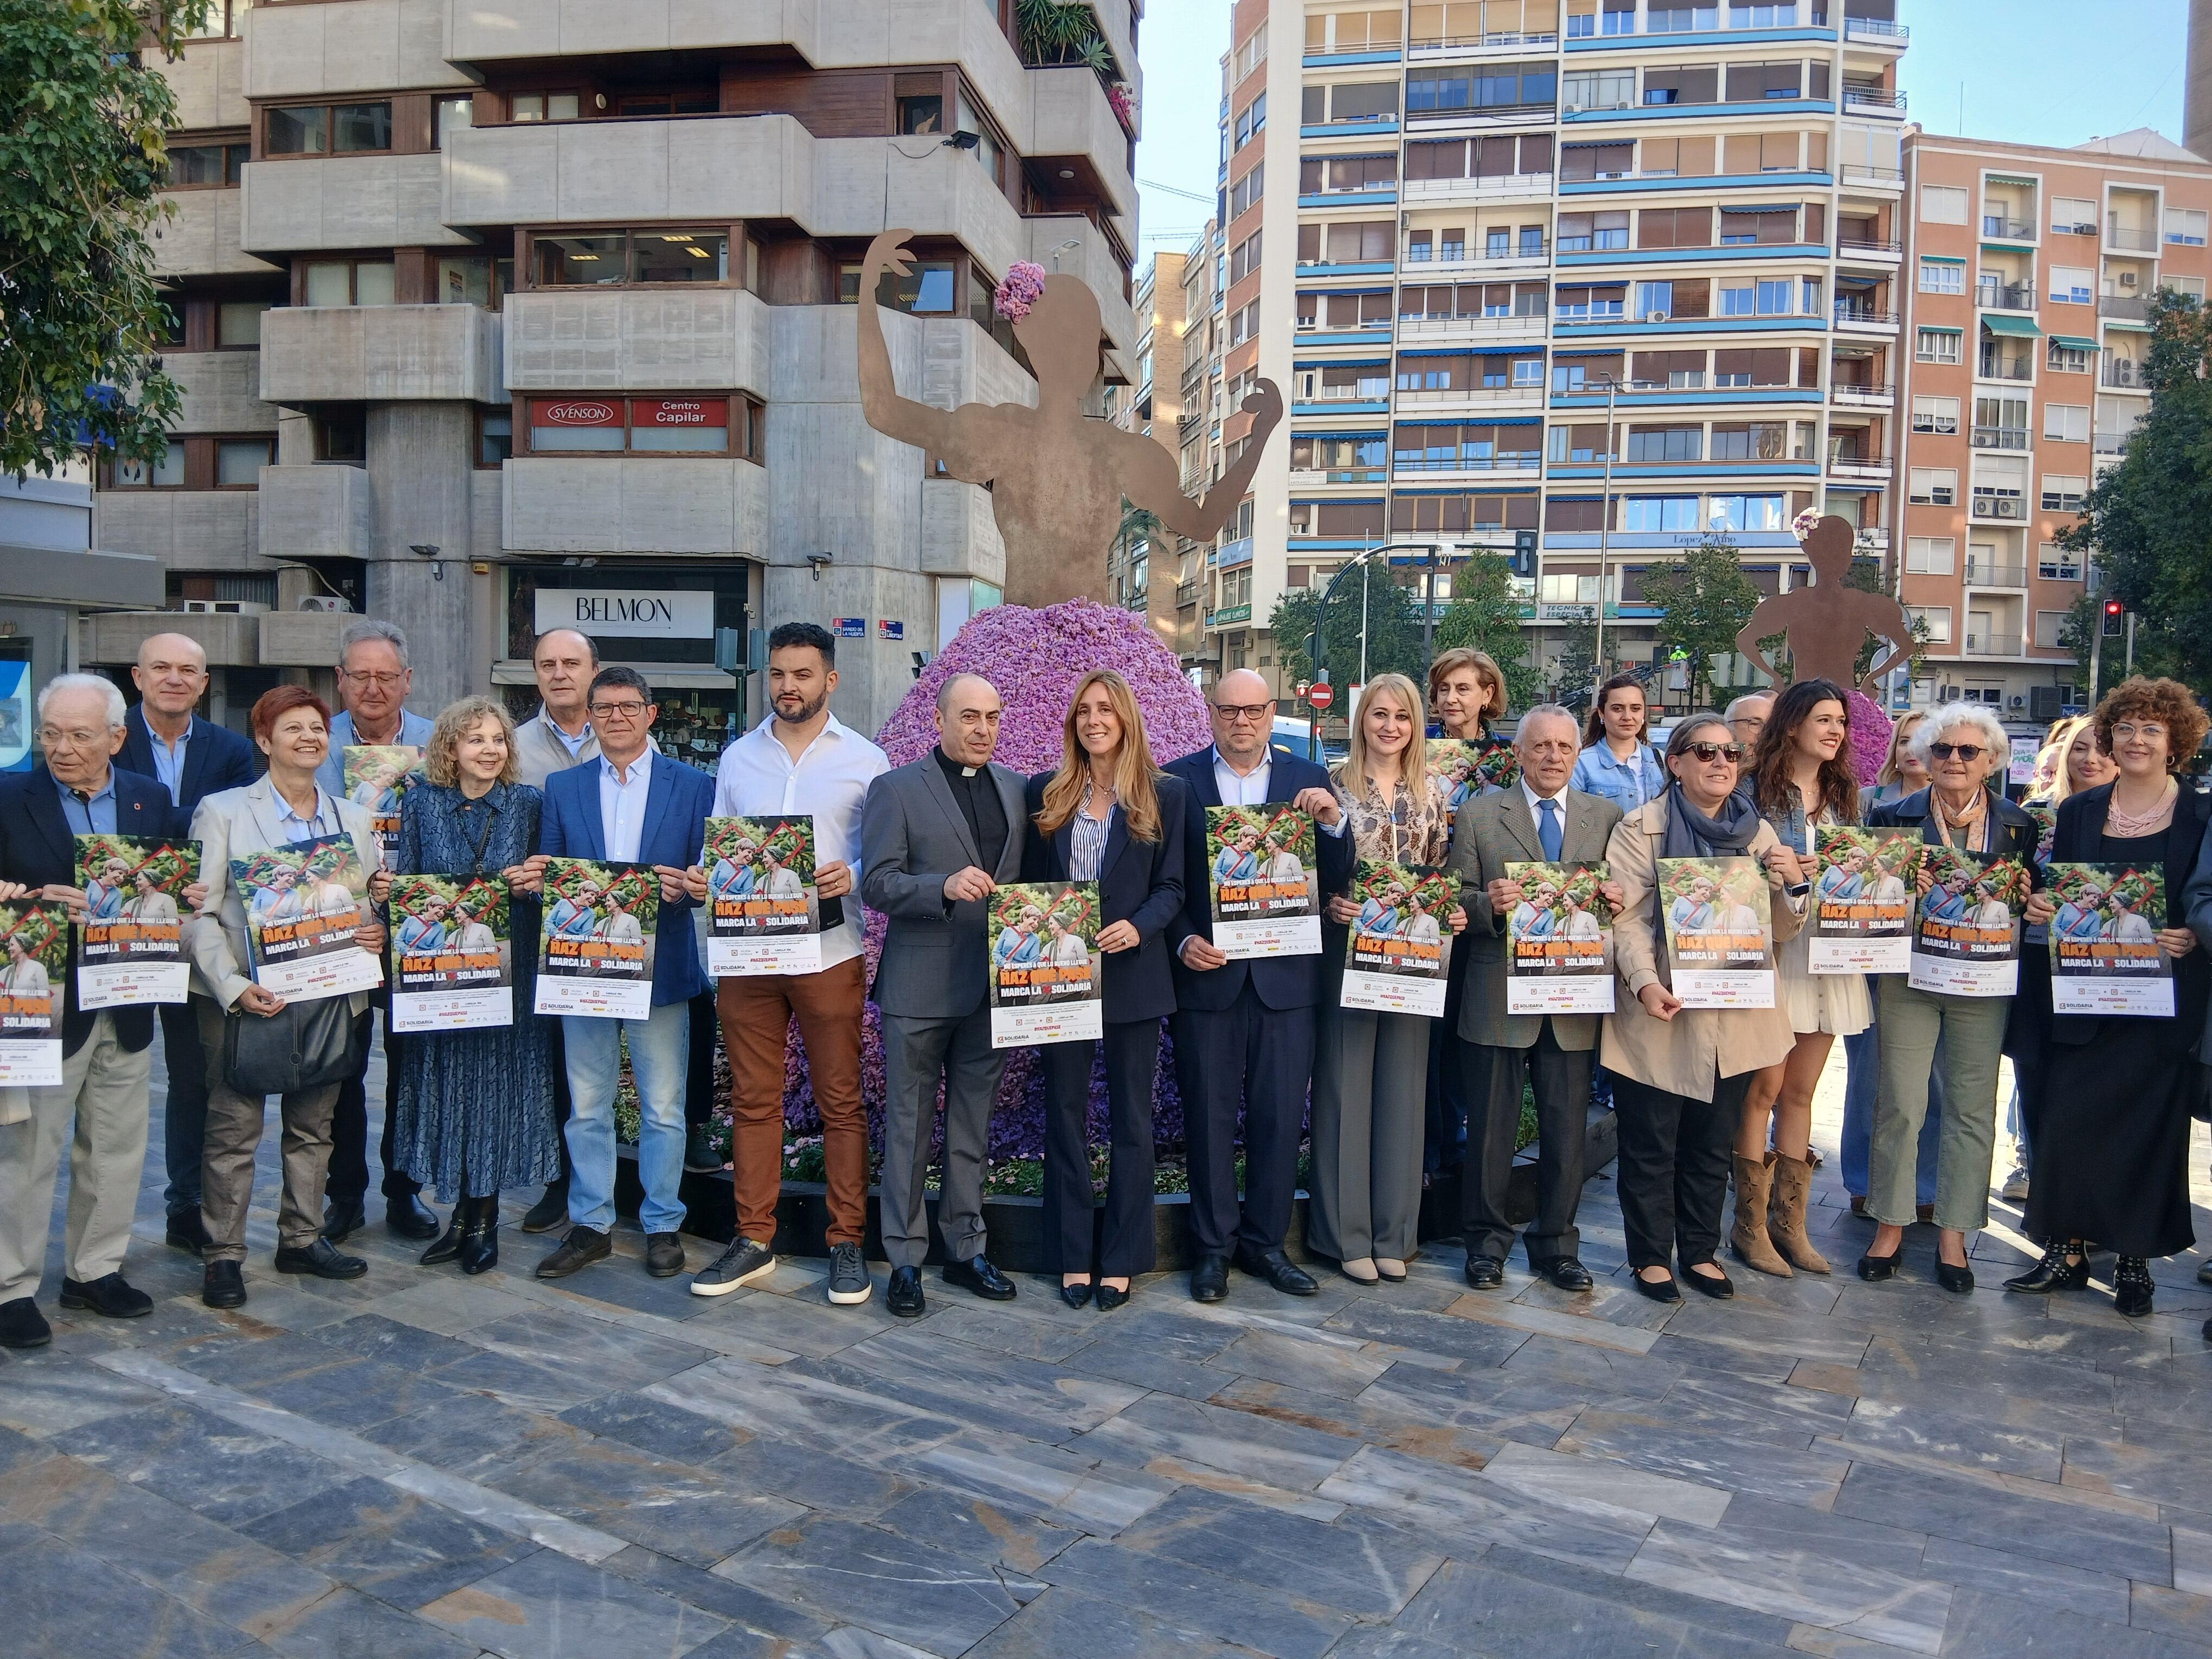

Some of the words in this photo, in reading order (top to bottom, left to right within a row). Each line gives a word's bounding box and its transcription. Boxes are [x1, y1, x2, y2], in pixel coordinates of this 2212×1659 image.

[554, 407, 607, 419] SVENSON
[661, 402, 700, 410] Centro
[655, 412, 706, 424] Capilar
[576, 597, 671, 622] BELMON
[1221, 886, 1246, 901] HAZ
[1249, 885, 1274, 899] QUE
[1276, 883, 1308, 897] PASE
[716, 902, 742, 916] HAZ
[745, 901, 771, 915] QUE
[773, 901, 808, 914] PASE
[1221, 902, 1249, 912] MARCA
[1250, 902, 1260, 910] LA
[1269, 898, 1309, 909] SOLIDARIA
[1821, 905, 1849, 918] HAZ
[1849, 905, 1875, 918] QUE
[1876, 906, 1908, 918] PASE
[262, 925, 294, 943] HAZ
[295, 919, 324, 937] QUE
[325, 912, 362, 930] PASE
[716, 918, 744, 927] MARCA
[746, 918, 756, 926] LA
[766, 916, 808, 925] SOLIDARIA
[86, 928, 107, 942] HAZ
[110, 926, 138, 942] QUE
[140, 926, 180, 940] PASE
[1922, 922, 1949, 938] HAZ
[1950, 928, 1978, 941] QUE
[1980, 929, 2012, 943] PASE
[86, 944, 108, 955] MARCA
[110, 943, 119, 953] LA
[130, 942, 179, 952] SOLIDARIA
[265, 943, 298, 955] MARCA
[298, 938, 311, 948] LA
[1356, 937, 1383, 953] HAZ
[1383, 941, 1409, 956] QUE
[1409, 943, 1443, 960] PASE
[1517, 943, 1543, 956] HAZ
[1545, 943, 1570, 955] QUE
[1572, 942, 1604, 955] PASE
[1678, 936, 1704, 949] HAZ
[1706, 936, 1731, 949] QUE
[1732, 936, 1764, 949] PASE
[1921, 937, 1949, 949] MARCA
[1950, 941, 1960, 950] LA
[1970, 943, 2011, 953] SOLIDARIA
[550, 941, 579, 955] HAZ
[580, 943, 608, 957] QUE
[609, 945, 646, 960] PASE
[2061, 943, 2089, 956] HAZ
[2091, 944, 2119, 957] QUE
[2121, 944, 2159, 957] PASE
[403, 957, 432, 972] HAZ
[434, 956, 462, 970] QUE
[465, 954, 501, 968] PASE
[549, 957, 580, 967] MARCA
[580, 959, 591, 967] LA
[600, 960, 644, 970] SOLIDARIA
[1355, 953, 1382, 963] MARCA
[1382, 956, 1393, 964] LA
[1400, 958, 1440, 969] SOLIDARIA
[1517, 959, 1545, 967] MARCA
[1565, 957, 1604, 966] SOLIDARIA
[2061, 959, 2092, 967] MARCA
[2114, 960, 2160, 968] SOLIDARIA
[403, 973, 434, 983] MARCA
[435, 973, 447, 981] LA
[456, 969, 501, 980] SOLIDARIA
[1000, 970, 1028, 986] HAZ
[1030, 969, 1057, 983] QUE
[1059, 967, 1092, 982] PASE
[1001, 987, 1030, 997] MARCA
[1031, 986, 1042, 995] LA
[1051, 982, 1092, 993] SOLIDARIA
[13, 999, 52, 1014] PASE
[3, 1017, 51, 1028] SOLIDARIA
